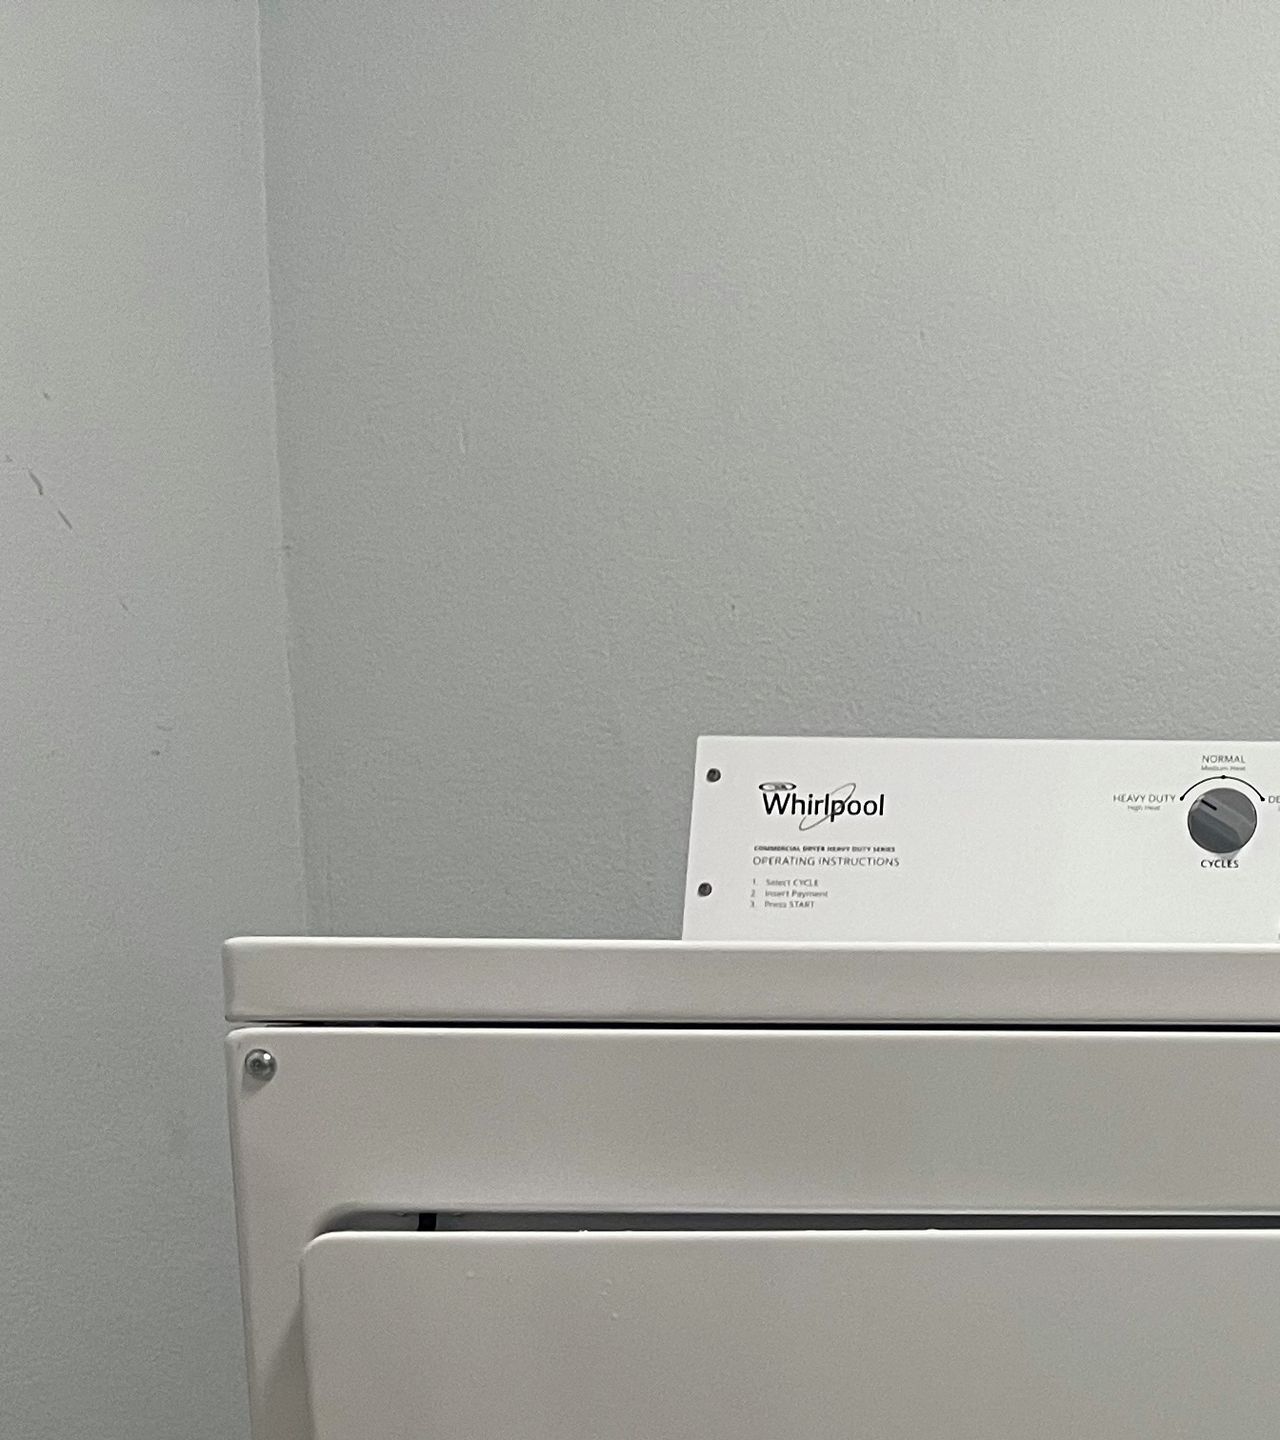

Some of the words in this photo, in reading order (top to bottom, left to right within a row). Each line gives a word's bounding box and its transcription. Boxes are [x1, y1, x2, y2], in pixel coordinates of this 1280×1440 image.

[1202, 755, 1246, 764] NORMAL
[1113, 794, 1145, 803] HEAVY
[1149, 794, 1176, 803] DUTY
[762, 792, 885, 823] Whirlpool
[752, 856, 815, 866] OPERATING
[819, 856, 900, 867] INSTRUCTIONS
[1200, 859, 1240, 869] CYCLES
